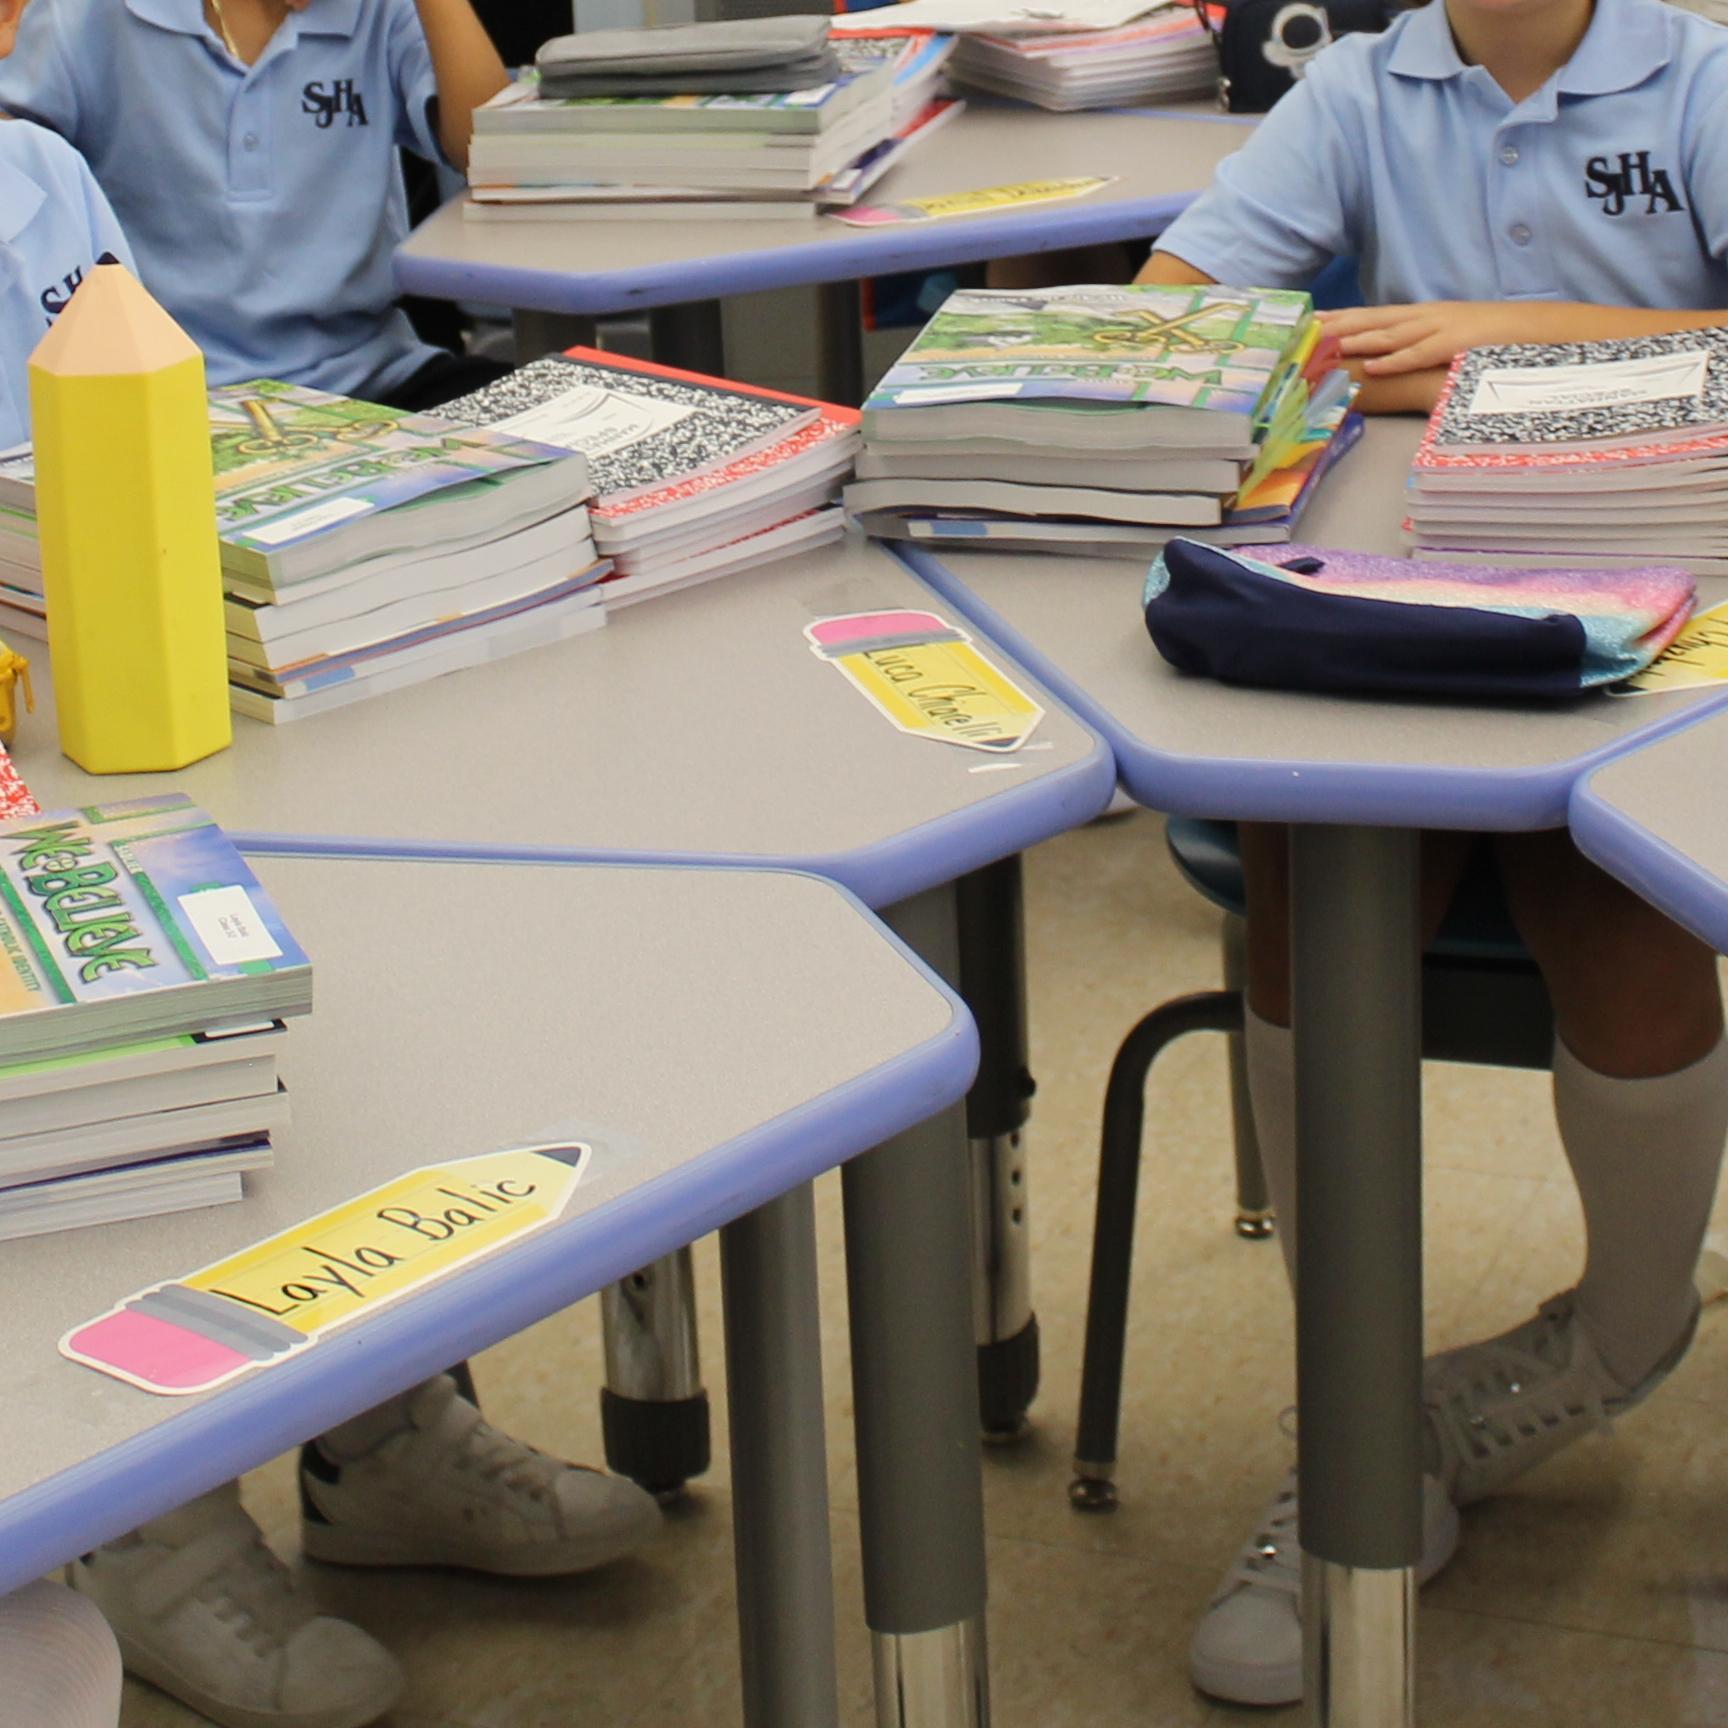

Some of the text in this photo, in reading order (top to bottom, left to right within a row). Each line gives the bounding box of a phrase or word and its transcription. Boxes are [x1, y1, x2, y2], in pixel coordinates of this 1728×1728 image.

[301, 78, 369, 129] SJHA
[1583, 149, 1687, 217] SJHA
[10, 955, 41, 992] IDENTITY
[208, 1176, 536, 1317] Layla Balic
